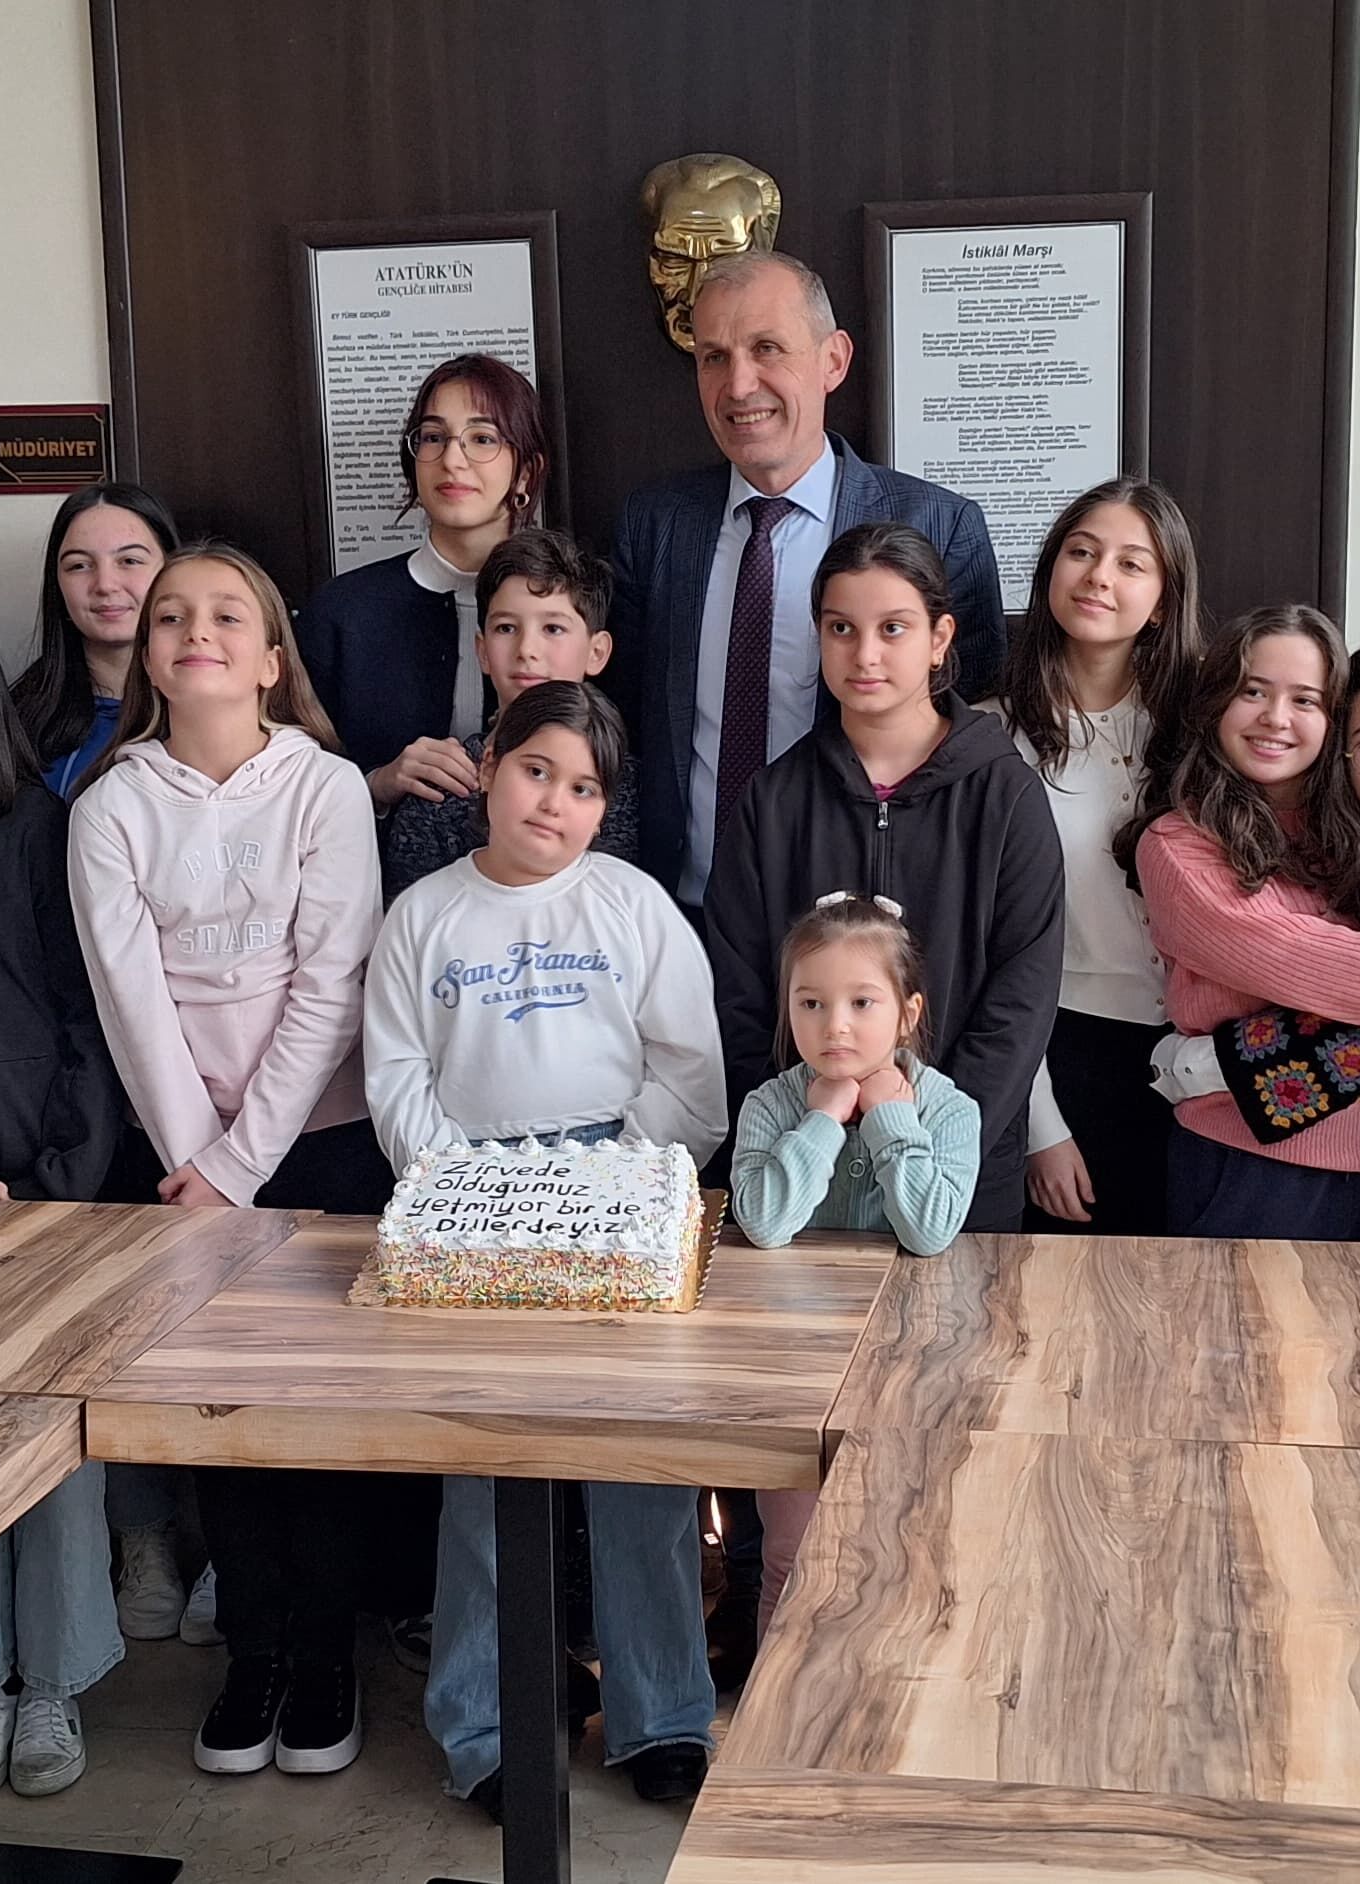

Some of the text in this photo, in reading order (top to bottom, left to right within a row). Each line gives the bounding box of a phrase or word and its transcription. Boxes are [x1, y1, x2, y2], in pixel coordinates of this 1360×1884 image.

[961, 243, 1053, 259] İstiklâl Marşı
[375, 260, 473, 282] ATATÜRK'ÜN
[377, 282, 473, 298] GENÇLİĞE HİTABESİ
[176, 918, 286, 954] STARS
[431, 958, 496, 1009] San
[481, 982, 587, 1004] CALIFORNIA
[441, 1160, 572, 1179] Zirvede
[406, 1197, 642, 1218] yetmiyor bir de
[434, 1217, 624, 1240] Dillerdeyiz
